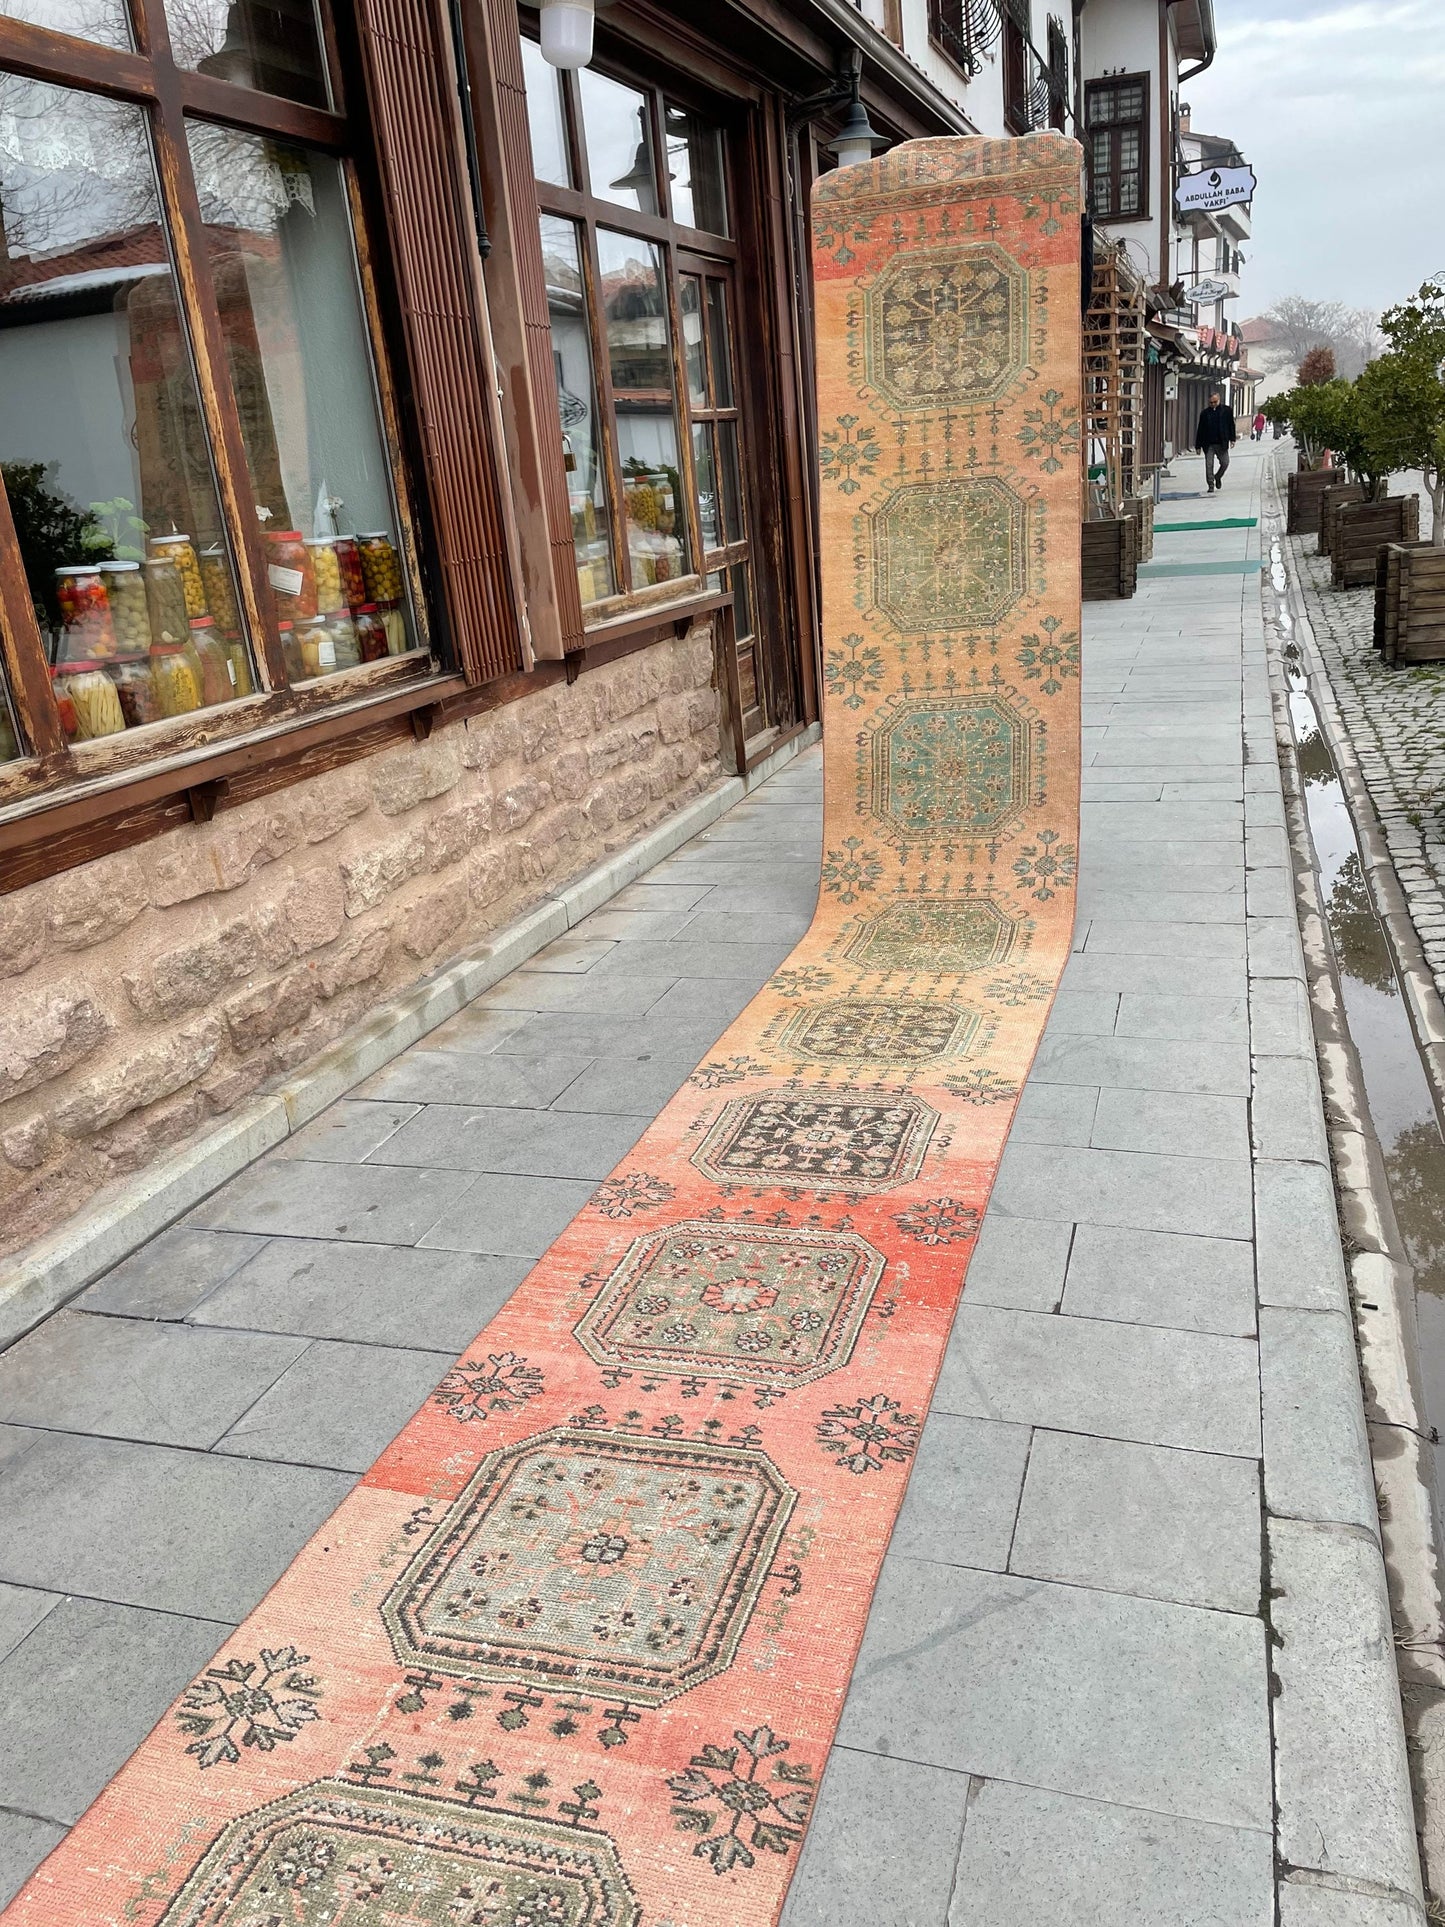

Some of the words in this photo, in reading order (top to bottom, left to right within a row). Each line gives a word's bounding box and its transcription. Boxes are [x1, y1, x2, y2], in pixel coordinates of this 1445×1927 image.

[1185, 190, 1223, 202] ABDULLAH
[1225, 186, 1245, 196] BABA
[1204, 198, 1226, 207] VAKFI
